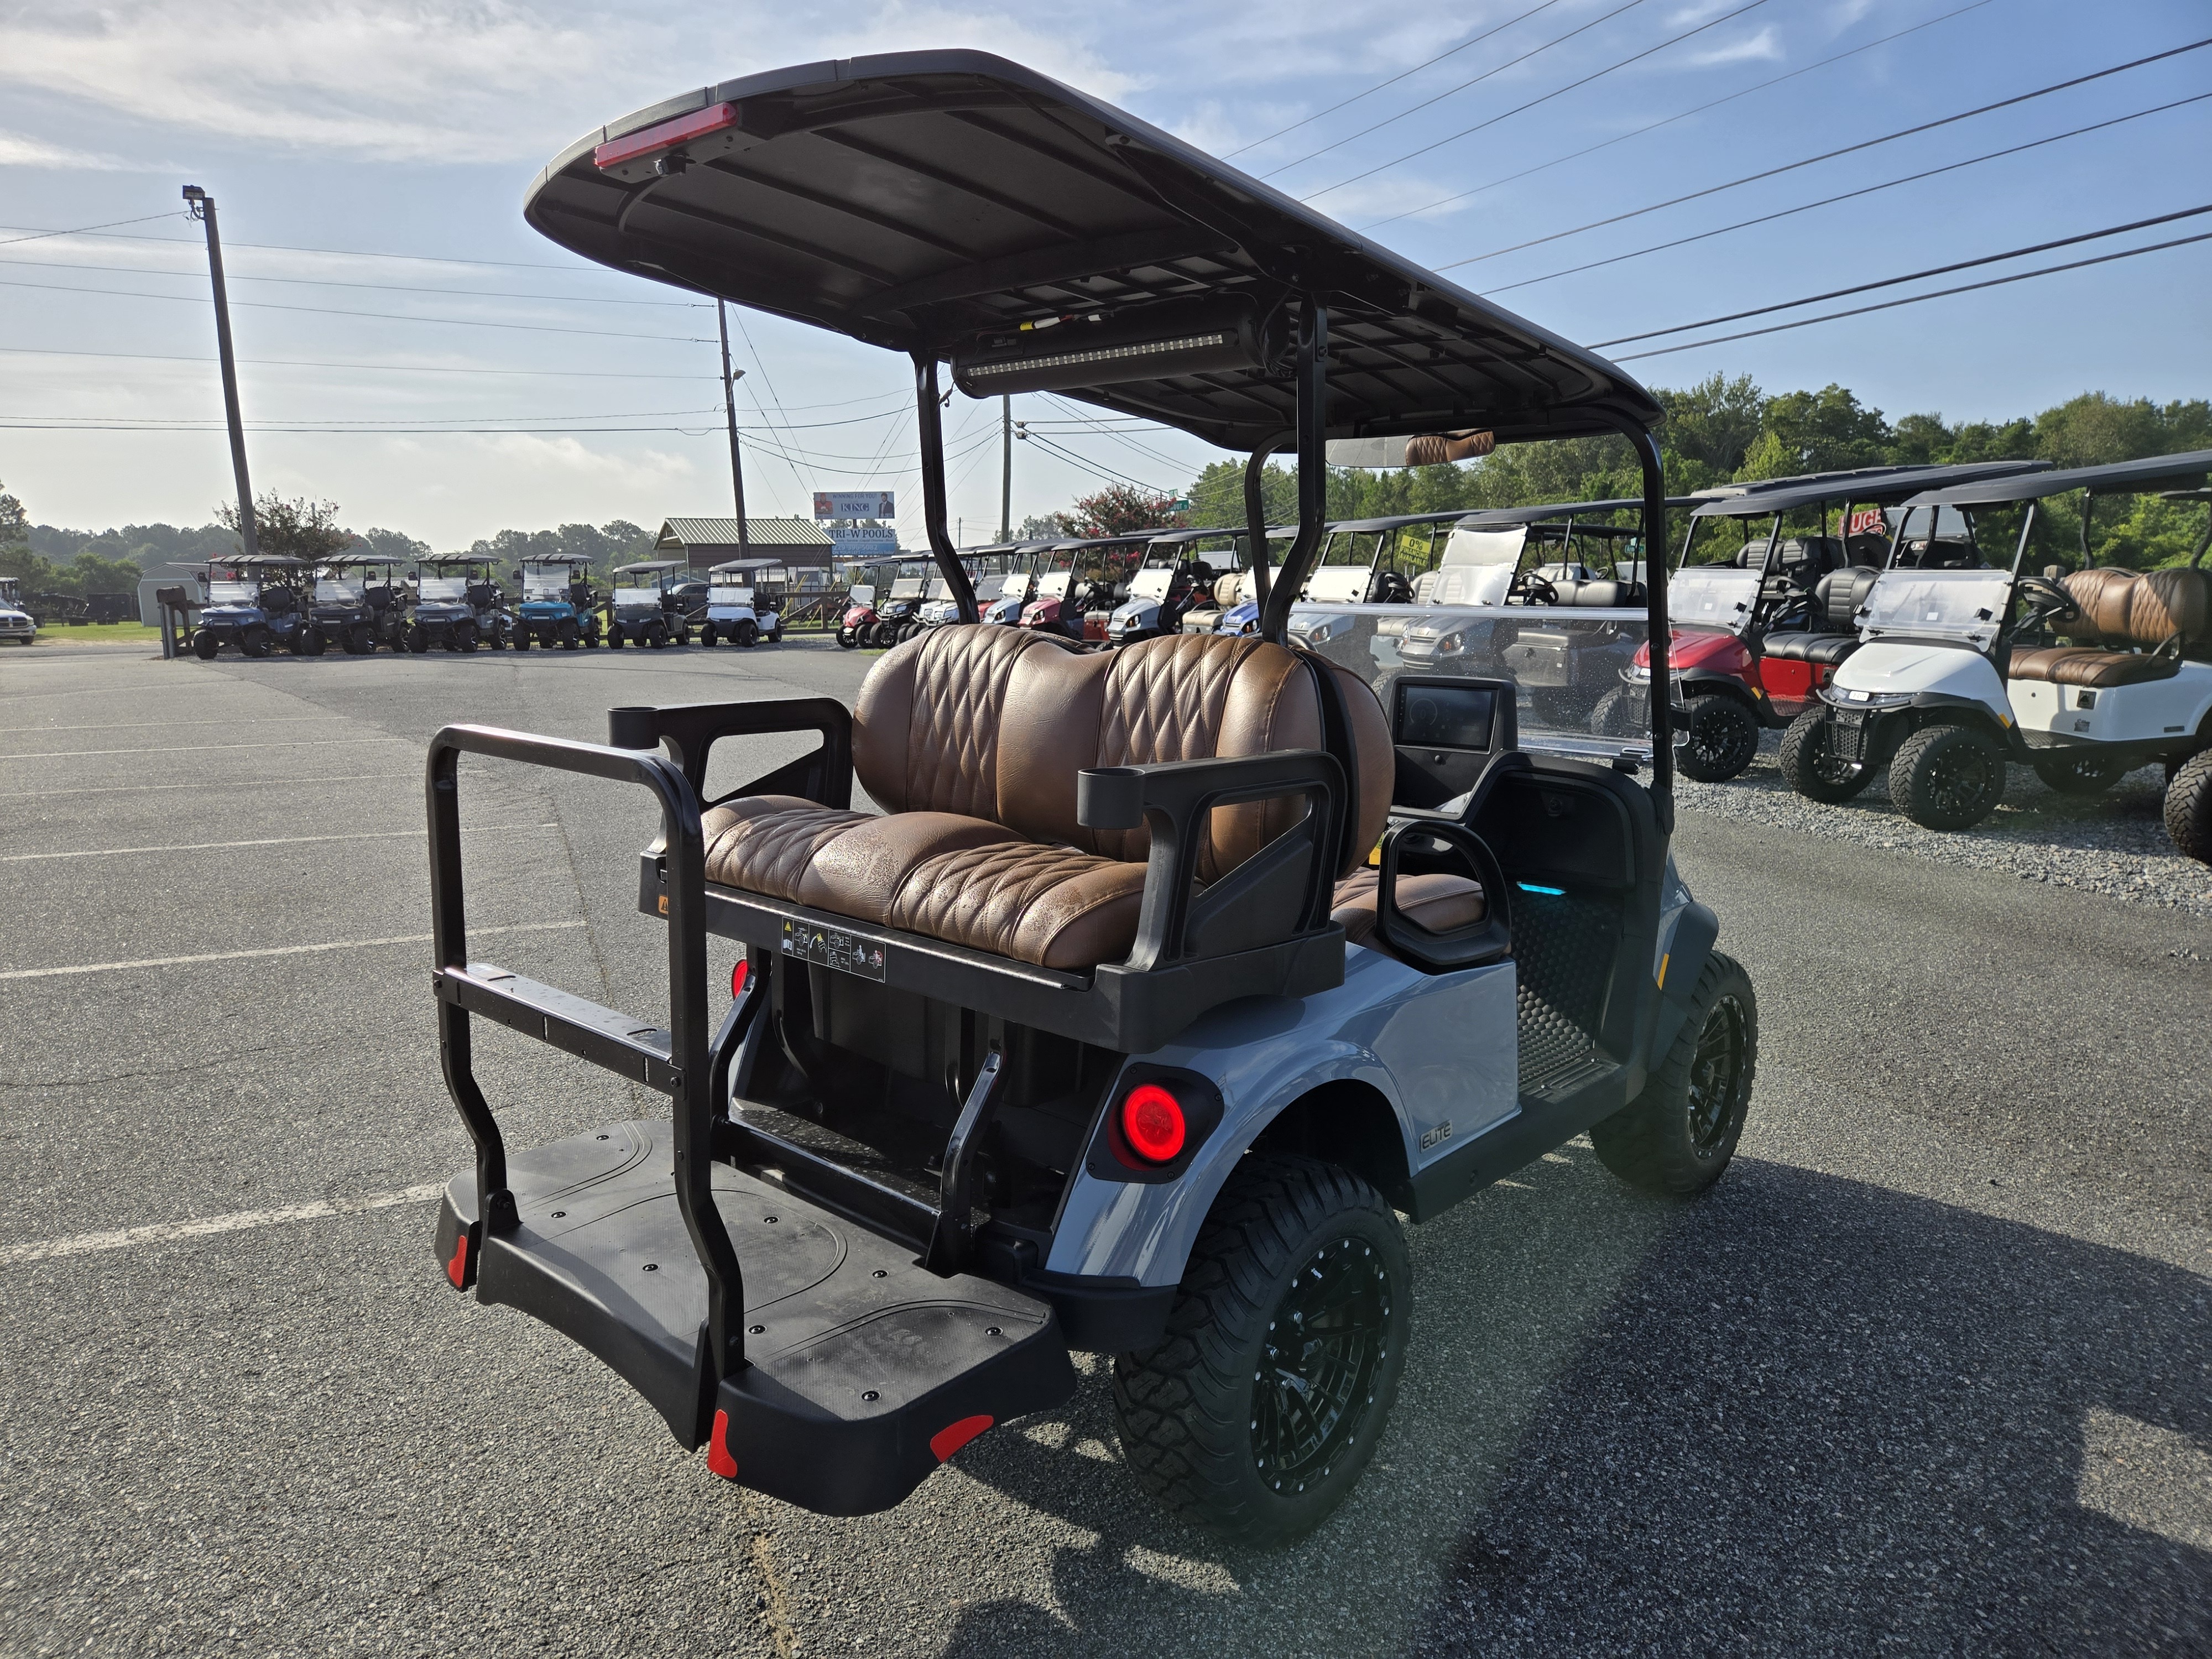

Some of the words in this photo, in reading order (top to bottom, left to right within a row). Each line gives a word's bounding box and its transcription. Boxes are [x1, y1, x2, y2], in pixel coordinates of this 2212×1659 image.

[829, 529, 860, 538] TRI-W
[863, 529, 893, 538] POOLS
[1409, 539, 1423, 551] 0%
[1399, 552, 1427, 566] AVAILABLE
[1401, 546, 1428, 560] FINANCING
